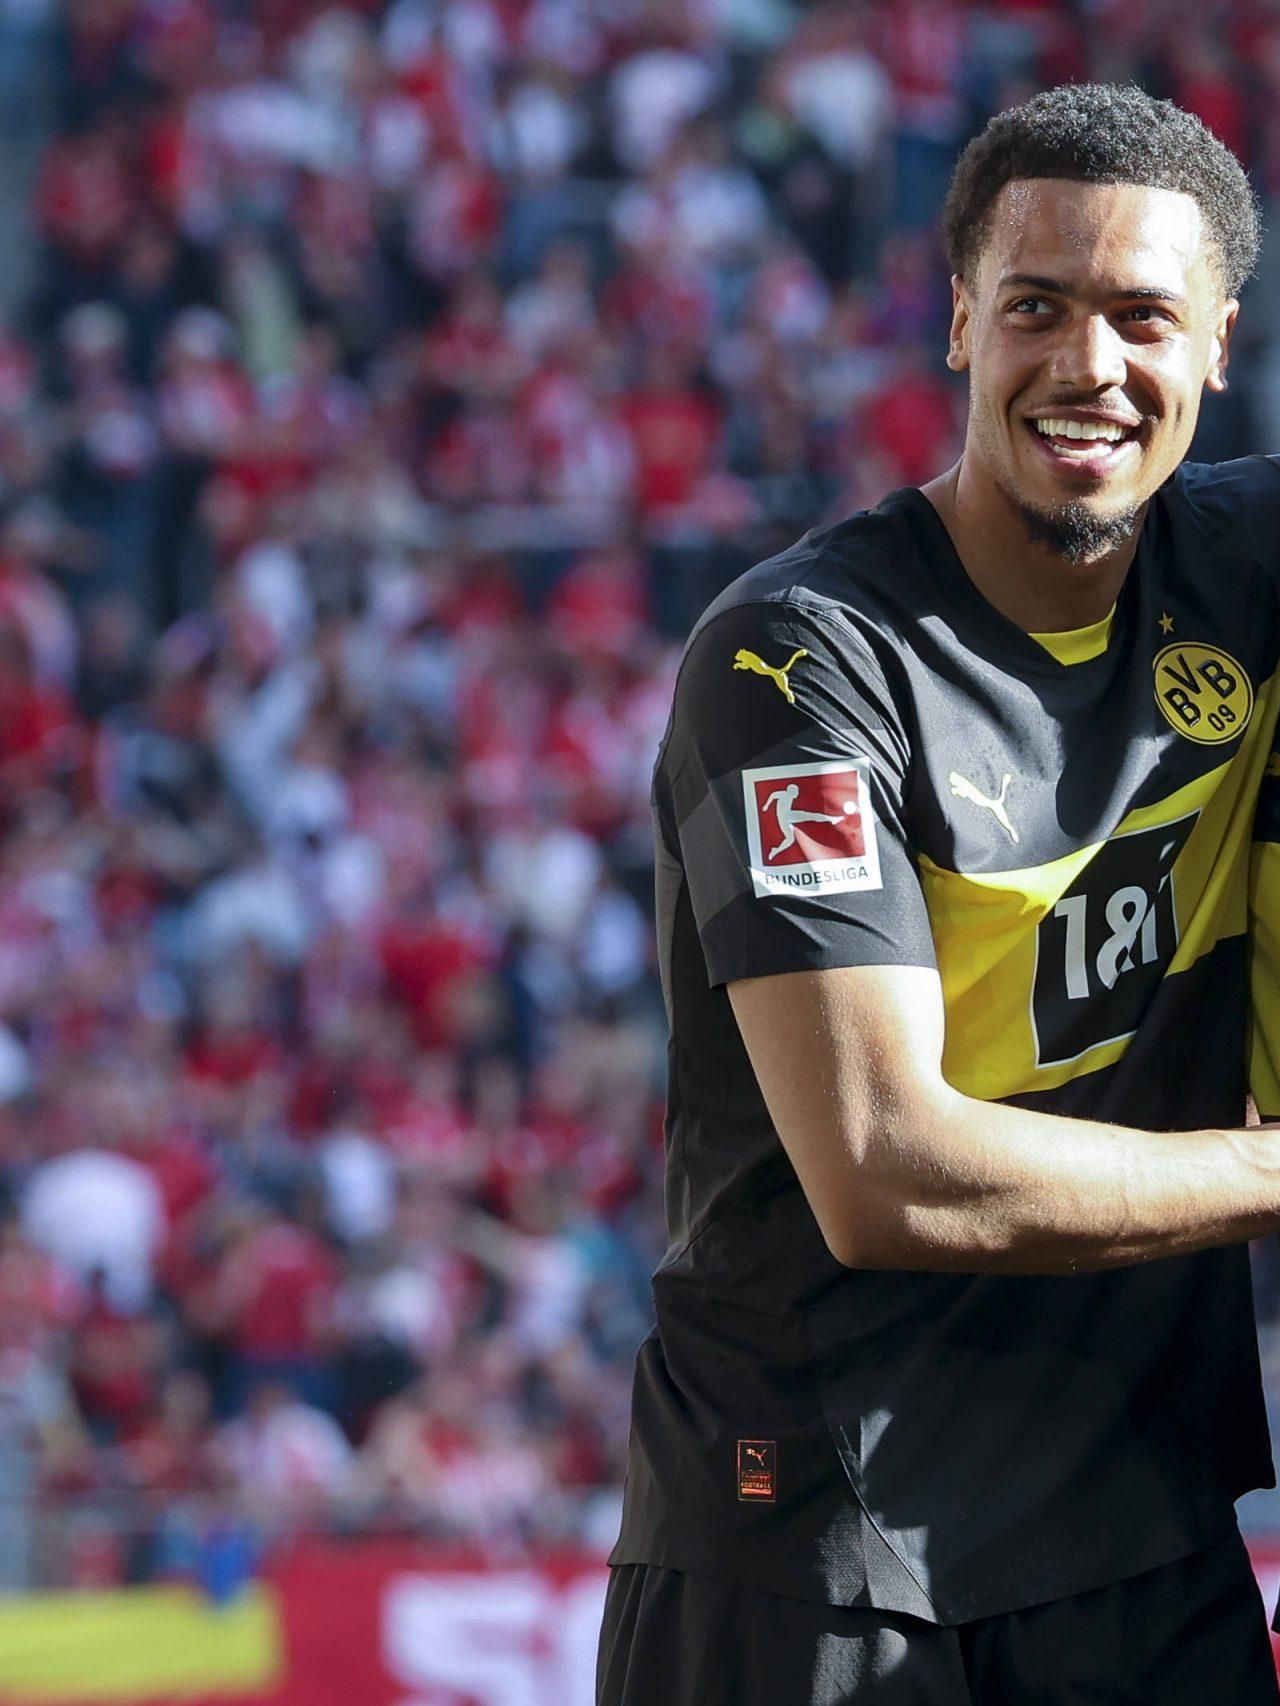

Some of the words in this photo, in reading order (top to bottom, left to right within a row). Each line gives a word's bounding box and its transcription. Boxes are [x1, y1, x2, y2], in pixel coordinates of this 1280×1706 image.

[1162, 652, 1237, 728] BVB
[1207, 704, 1237, 732] 09
[766, 866, 869, 887] BUNDESLIGA
